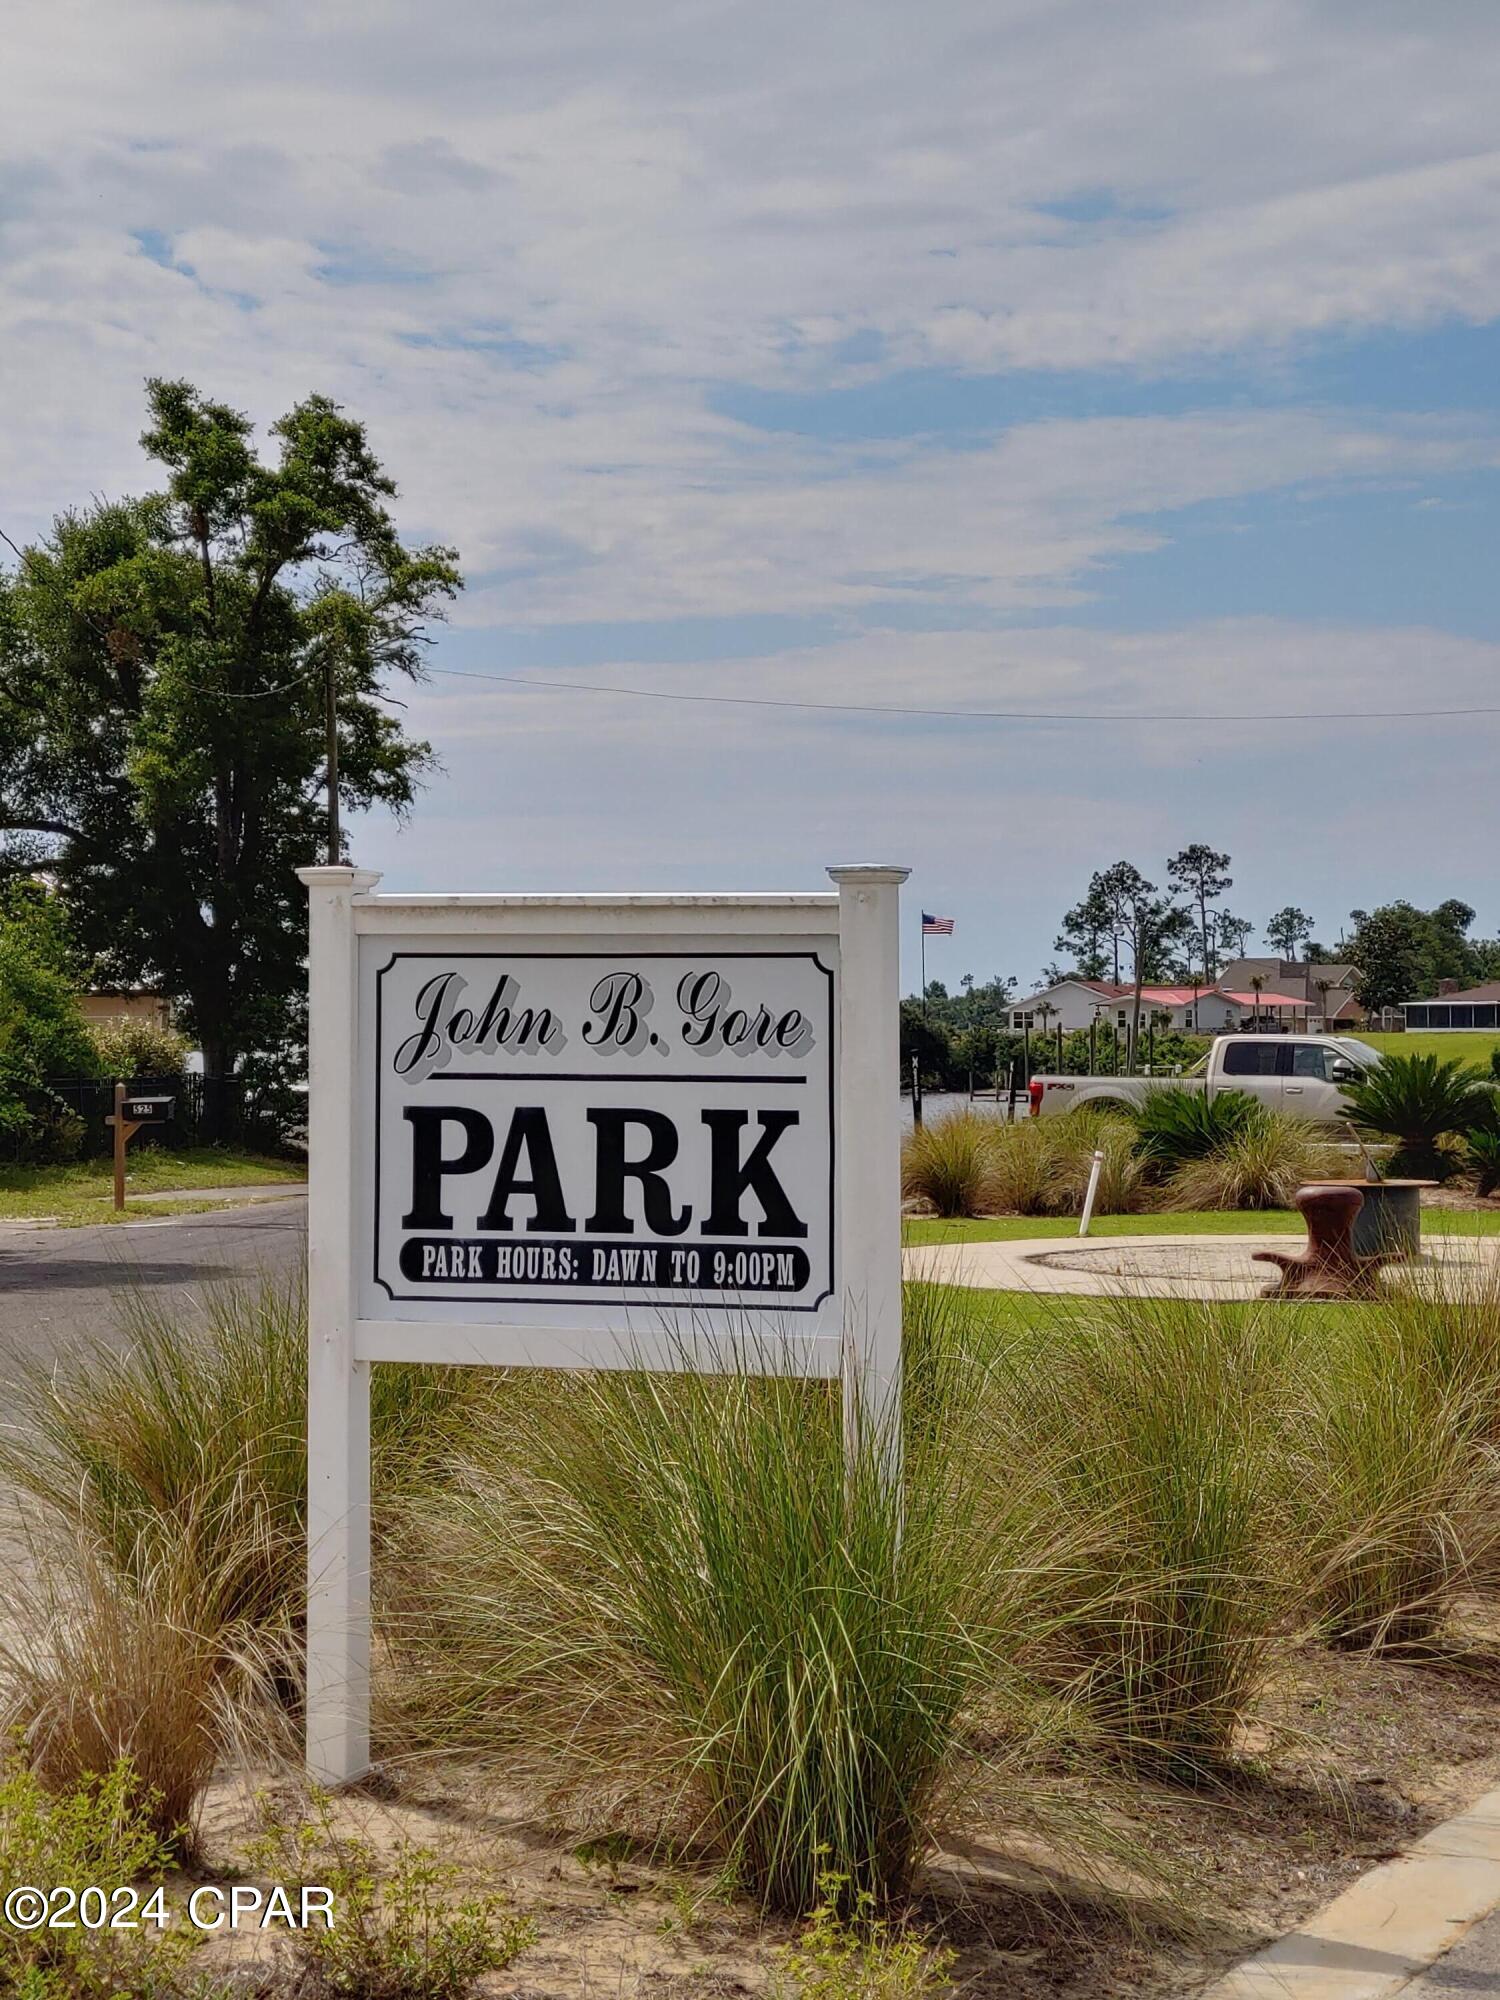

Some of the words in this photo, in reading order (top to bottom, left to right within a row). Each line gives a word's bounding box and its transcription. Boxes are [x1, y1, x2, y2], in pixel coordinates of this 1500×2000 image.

[393, 972, 558, 1075] John
[582, 971, 660, 1047] B.
[675, 971, 807, 1048] Gore
[401, 1105, 808, 1239] PARK
[421, 1245, 484, 1279] PARK
[496, 1246, 580, 1281] HOURS:
[591, 1248, 658, 1282] DAWN
[671, 1250, 700, 1284] TO
[713, 1250, 796, 1286] 9:00PM
